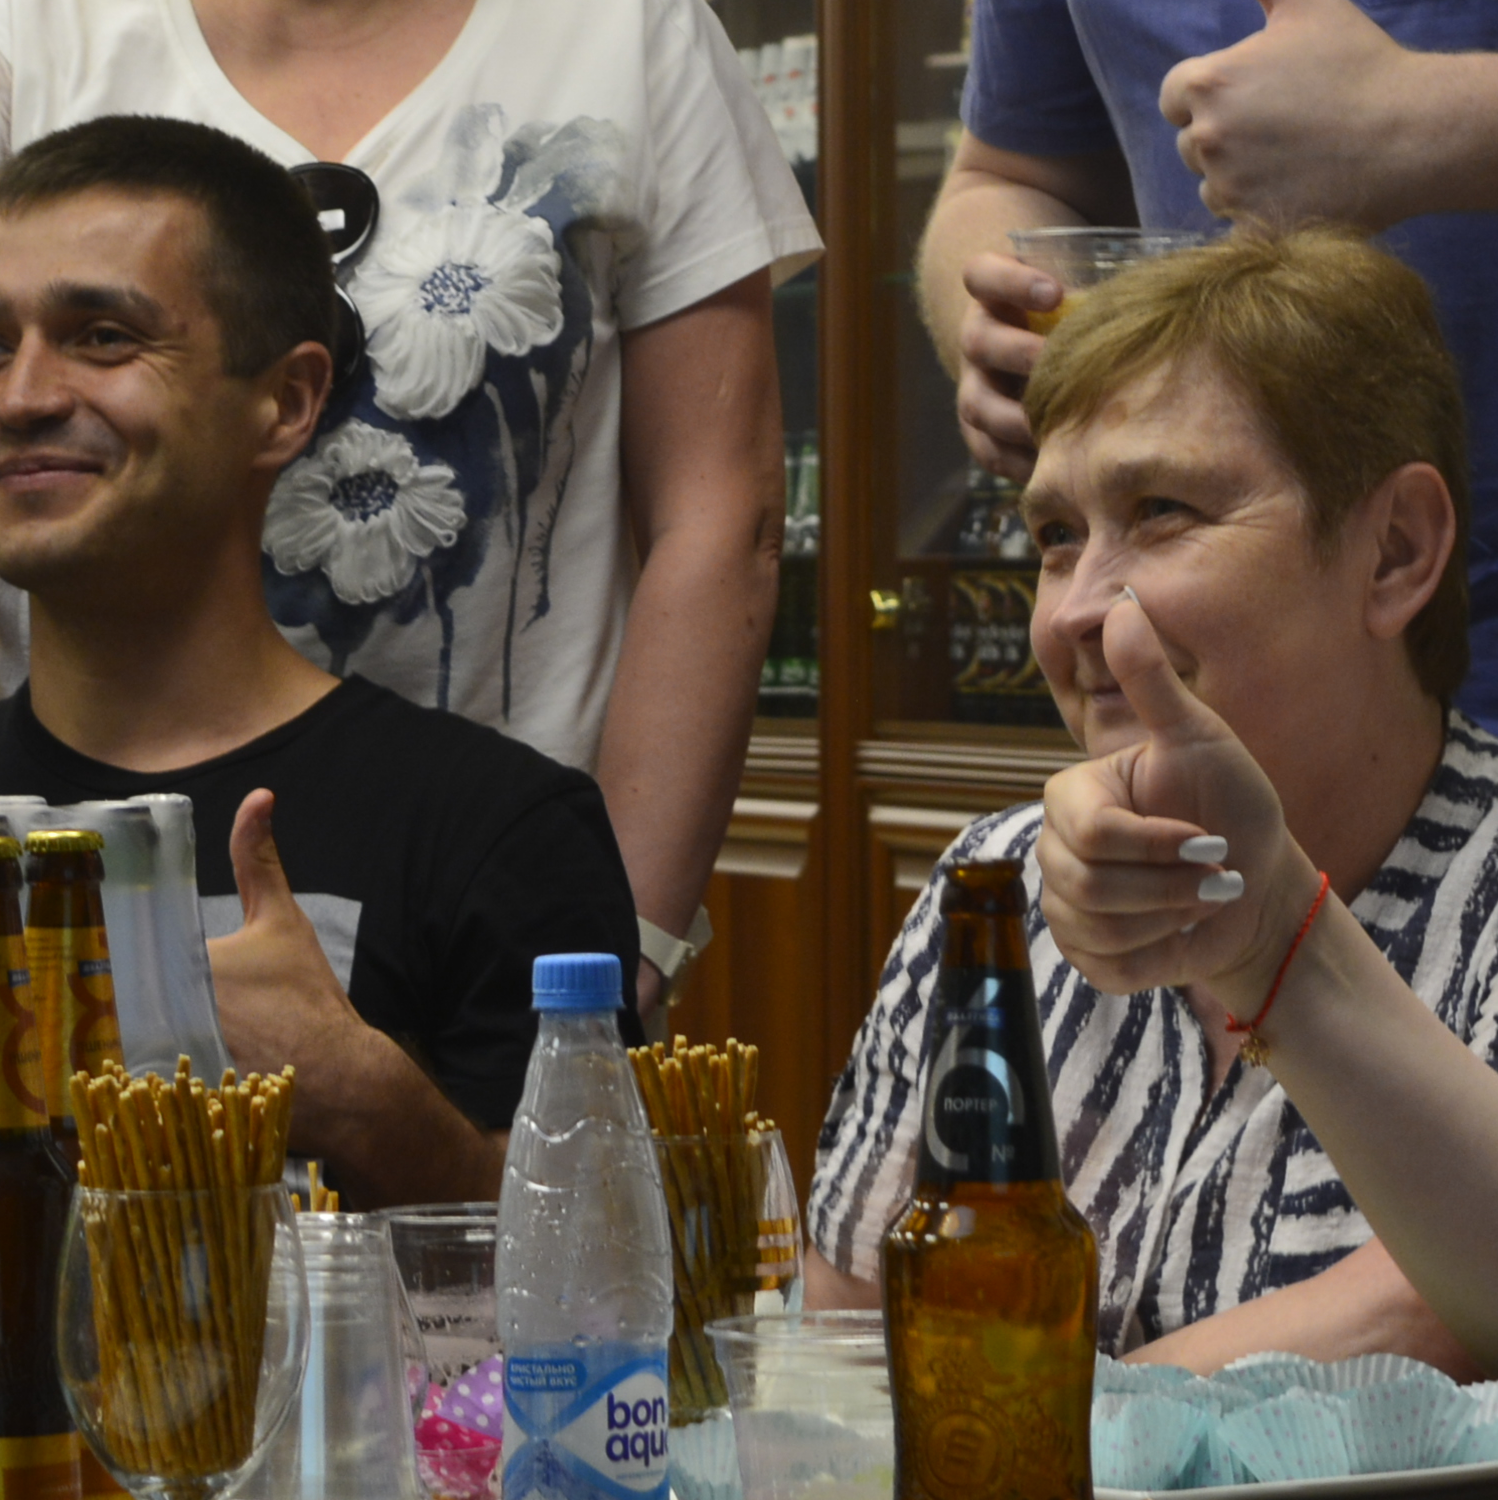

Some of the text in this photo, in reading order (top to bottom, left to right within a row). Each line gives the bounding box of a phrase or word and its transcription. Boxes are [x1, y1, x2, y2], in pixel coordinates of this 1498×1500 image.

[943, 1096, 999, 1113] ПОРТЕР
[549, 1376, 578, 1388] ВКУС
[606, 1392, 665, 1431] bon
